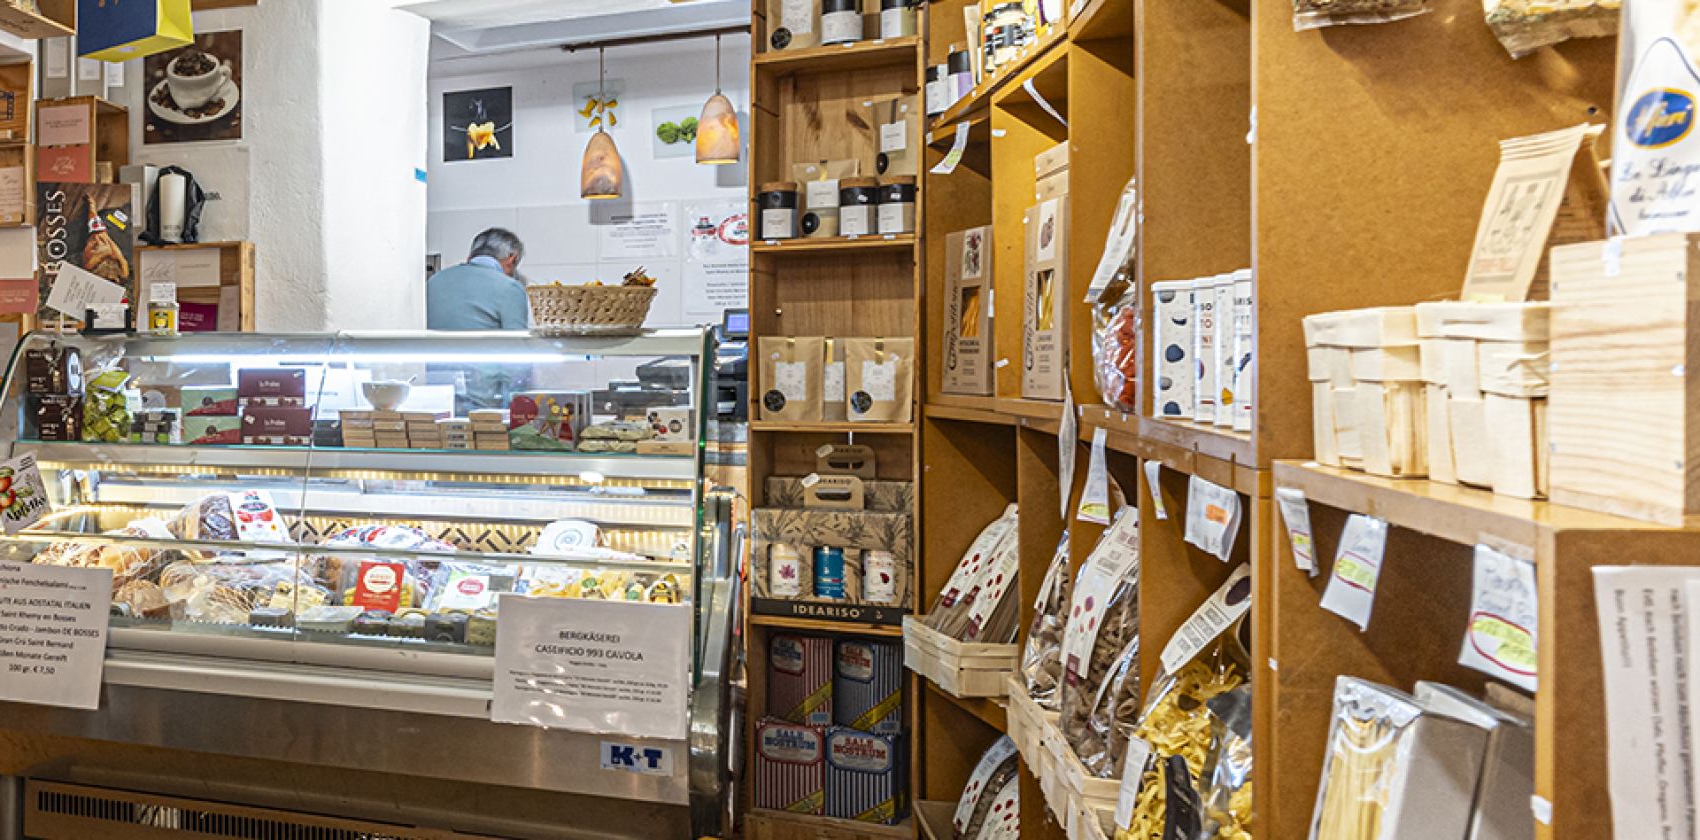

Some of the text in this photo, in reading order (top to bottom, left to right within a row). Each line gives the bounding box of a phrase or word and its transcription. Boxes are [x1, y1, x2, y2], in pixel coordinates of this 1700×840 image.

[13, 597, 27, 606] AUS
[64, 601, 91, 610] ITALIEN
[793, 604, 861, 618] IDEARISO
[74, 628, 99, 638] BOSSES
[559, 630, 621, 644] BERGKÄSEREI
[535, 645, 585, 657] CASEIFICIO
[605, 651, 644, 661] CAVOLA
[611, 745, 663, 768] K+T
